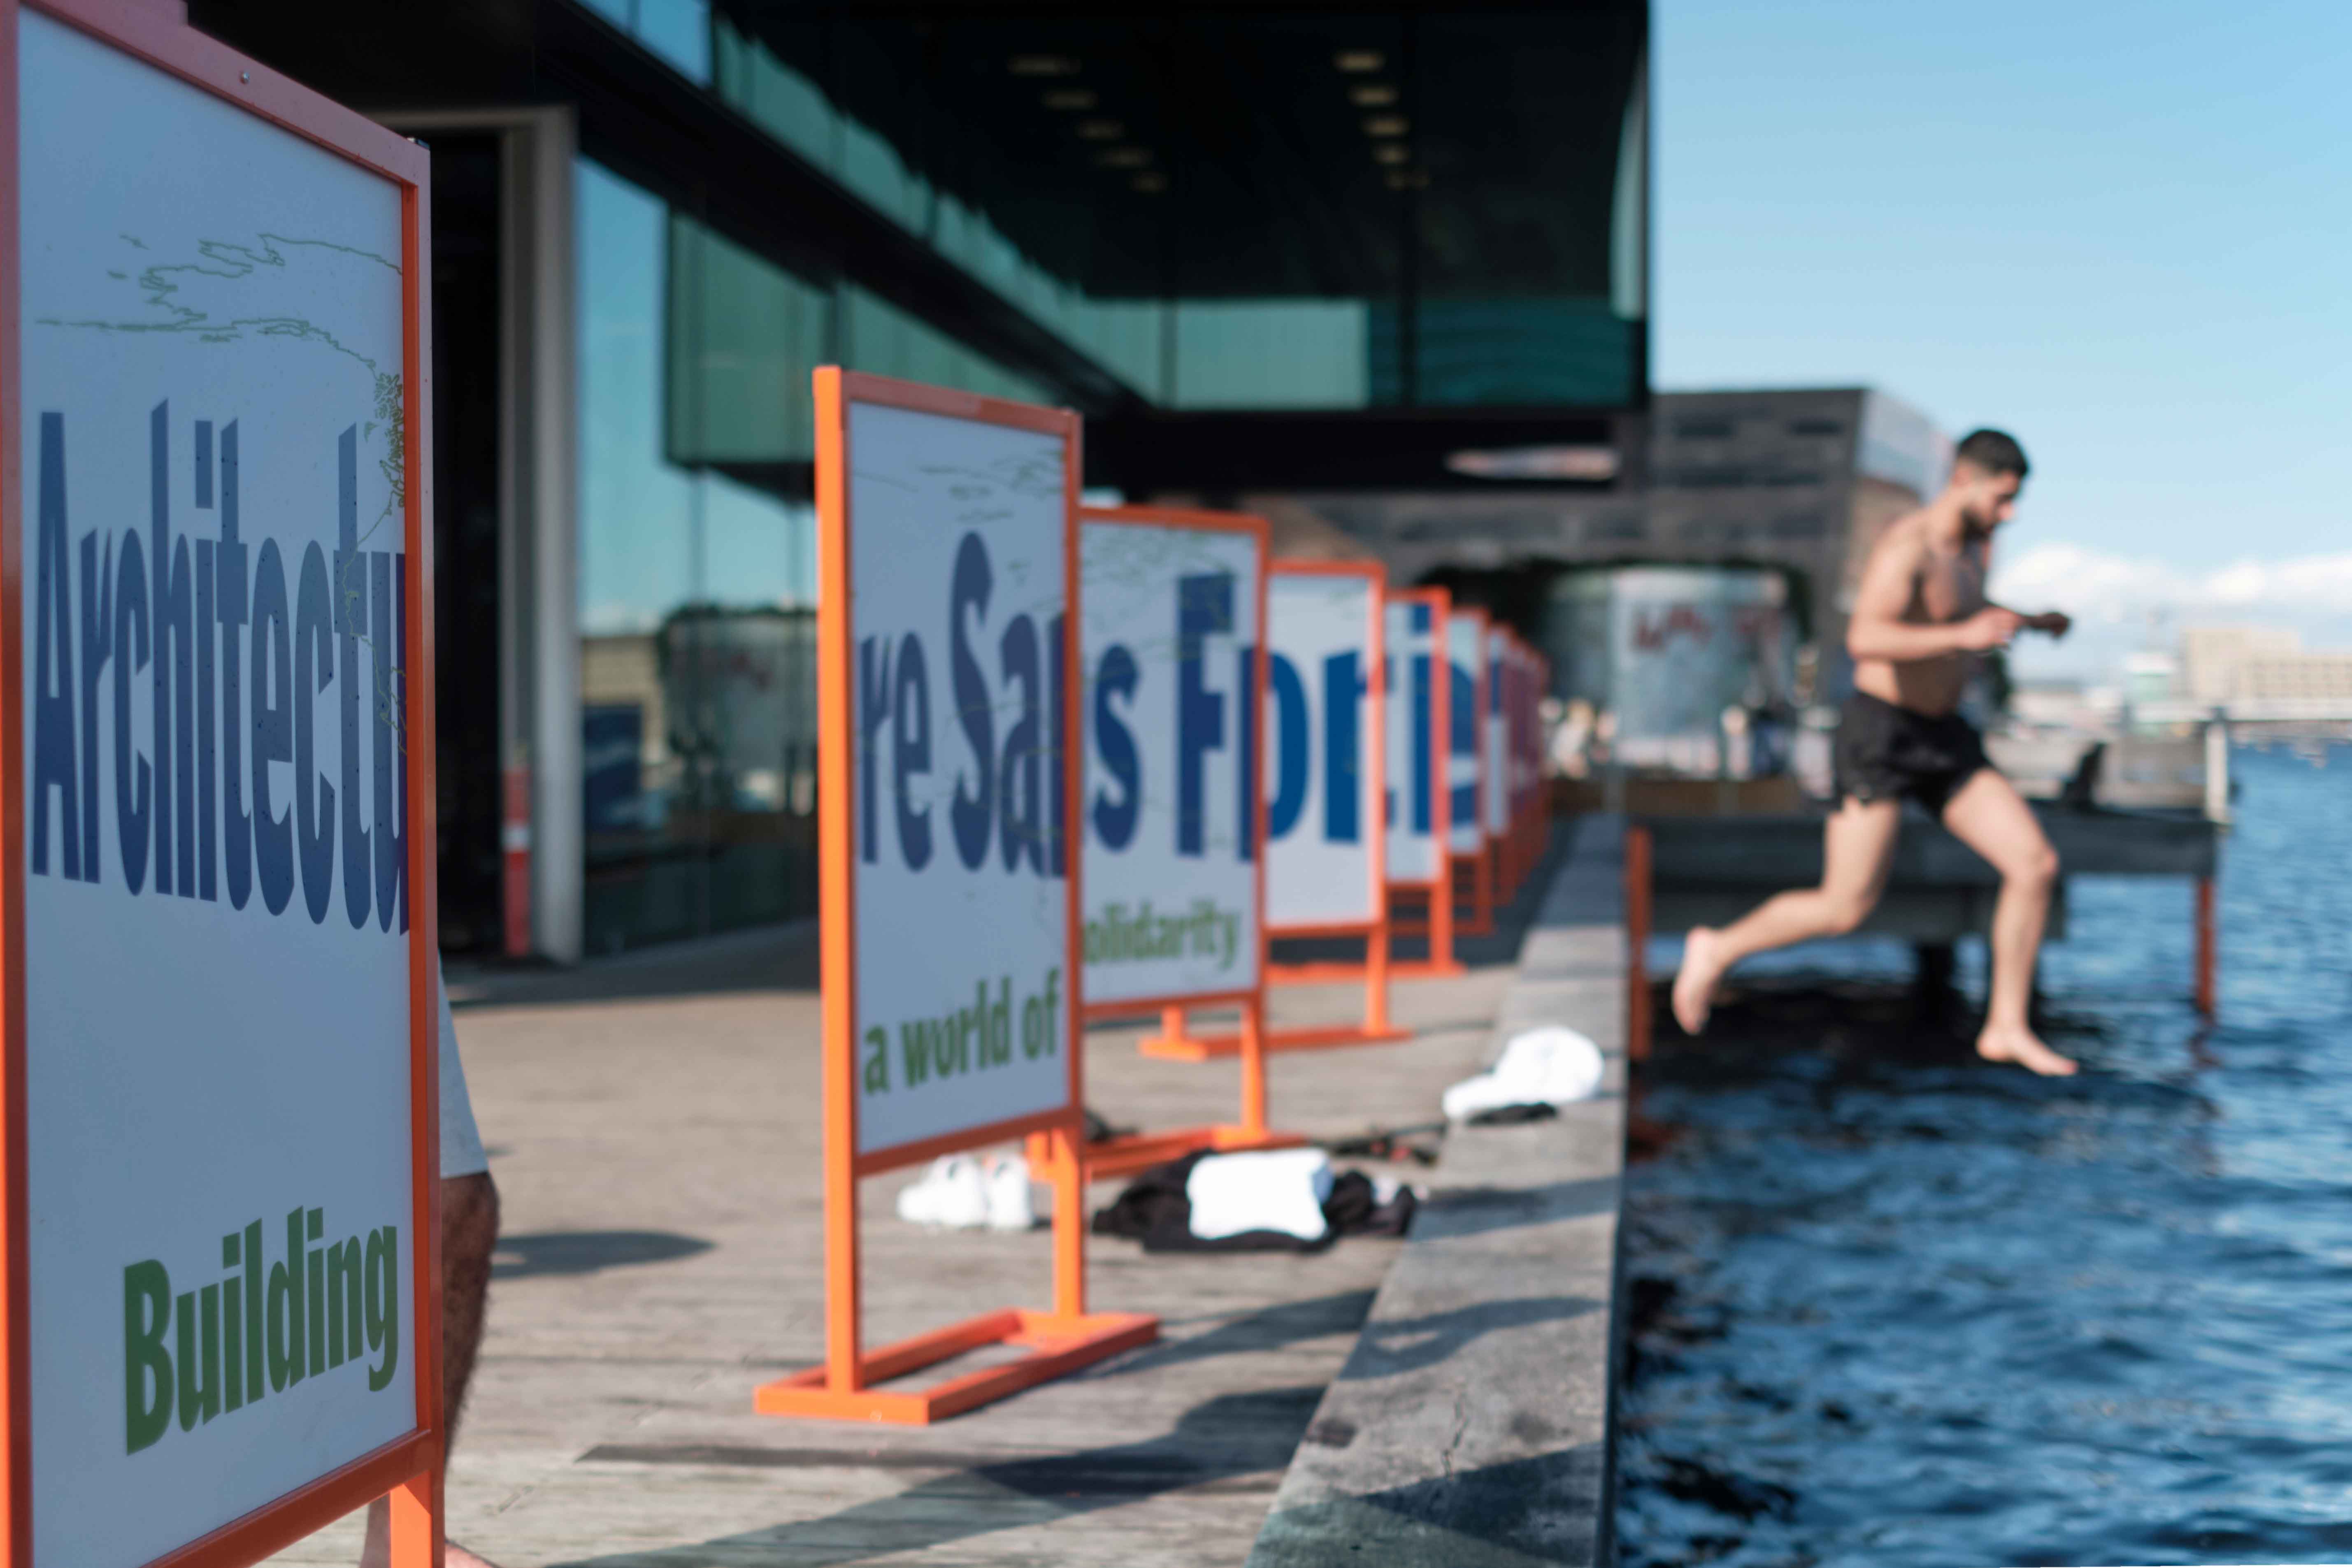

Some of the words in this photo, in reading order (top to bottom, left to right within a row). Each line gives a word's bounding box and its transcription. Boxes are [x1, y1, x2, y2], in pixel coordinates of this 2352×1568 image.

[1082, 898, 1241, 973] olidarity
[864, 1021, 890, 1096] a
[899, 974, 1013, 1088] world
[1021, 965, 1061, 1062] of
[124, 1205, 399, 1456] Building
